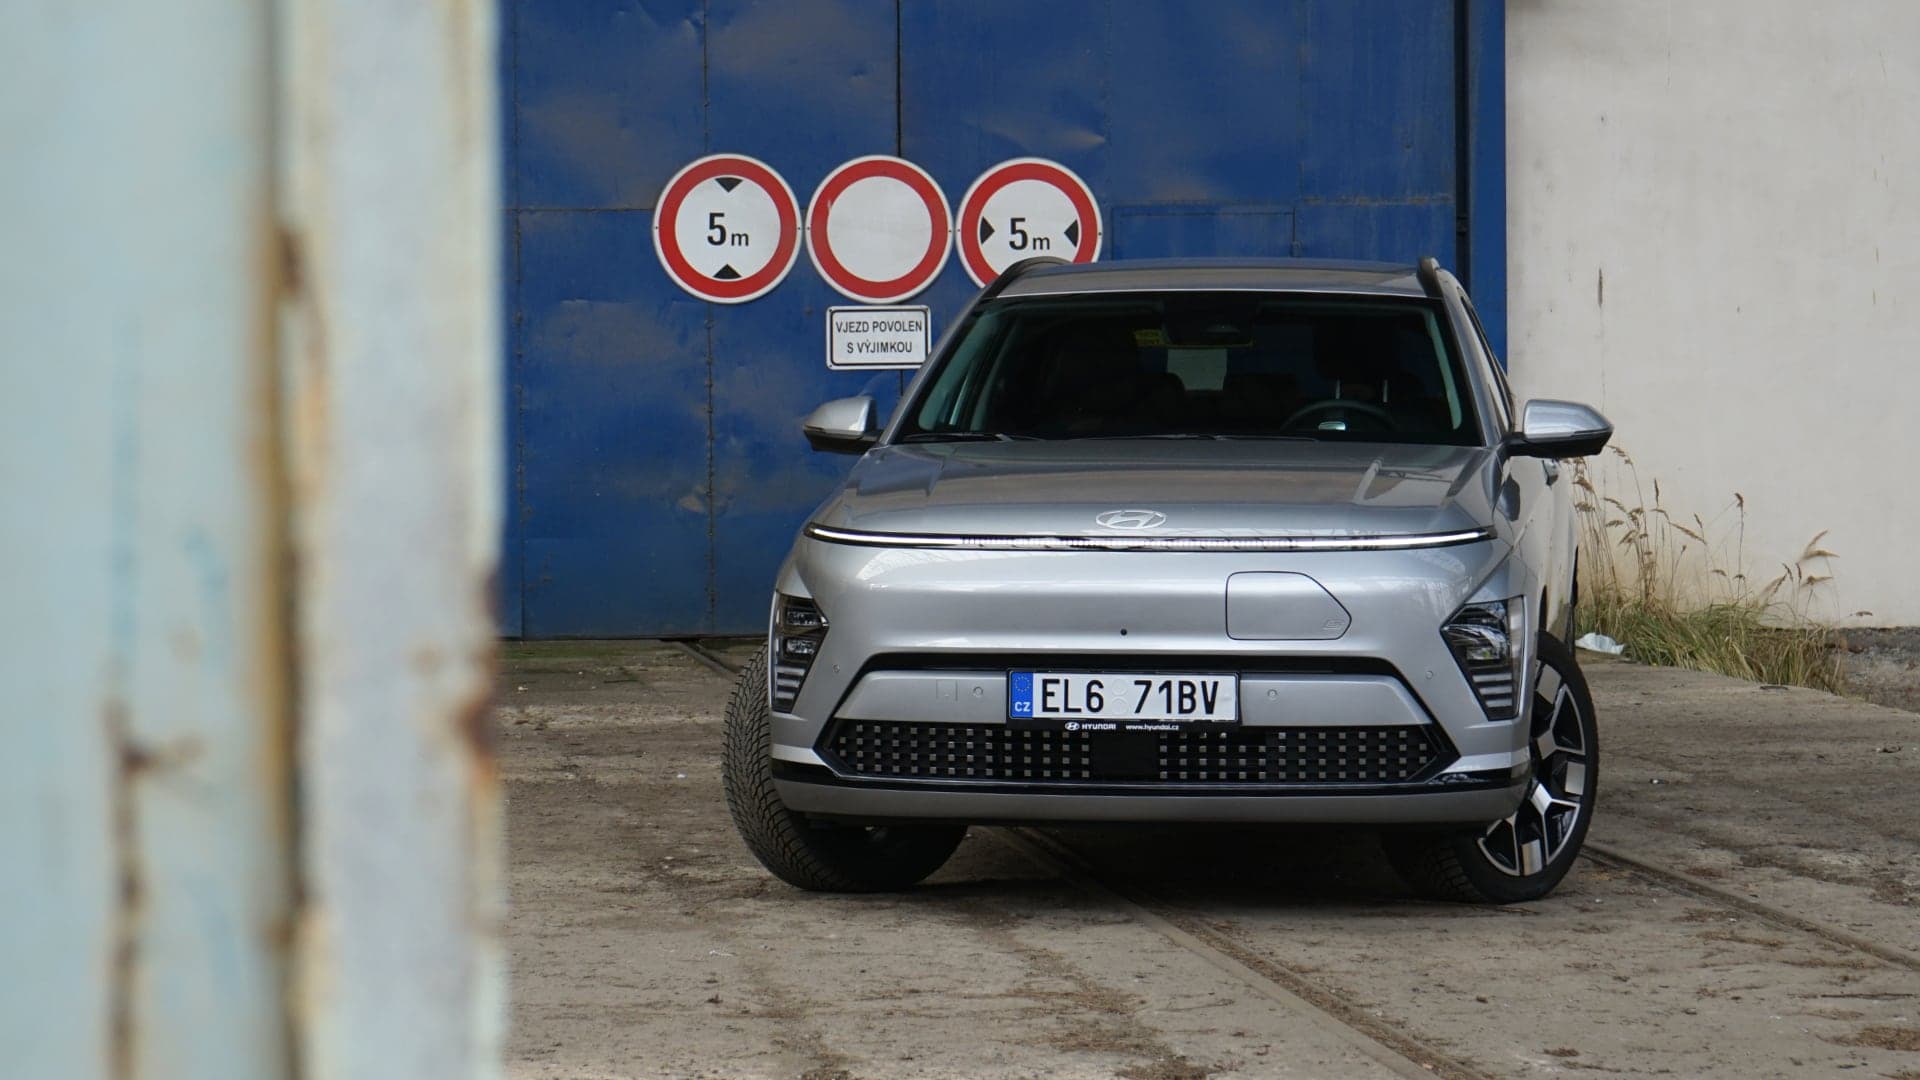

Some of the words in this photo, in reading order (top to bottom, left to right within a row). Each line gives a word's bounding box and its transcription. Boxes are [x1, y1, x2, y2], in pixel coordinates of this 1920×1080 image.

[835, 321, 869, 334] VJEZD
[872, 320, 923, 333] POVOLEN
[846, 341, 854, 354] S
[857, 338, 912, 354] VÝJIMKOU
[1041, 678, 1104, 714] EL6
[1133, 679, 1219, 715] 71BV
[1014, 701, 1031, 713] CZ
[1080, 723, 1117, 731] HYUNDAI
